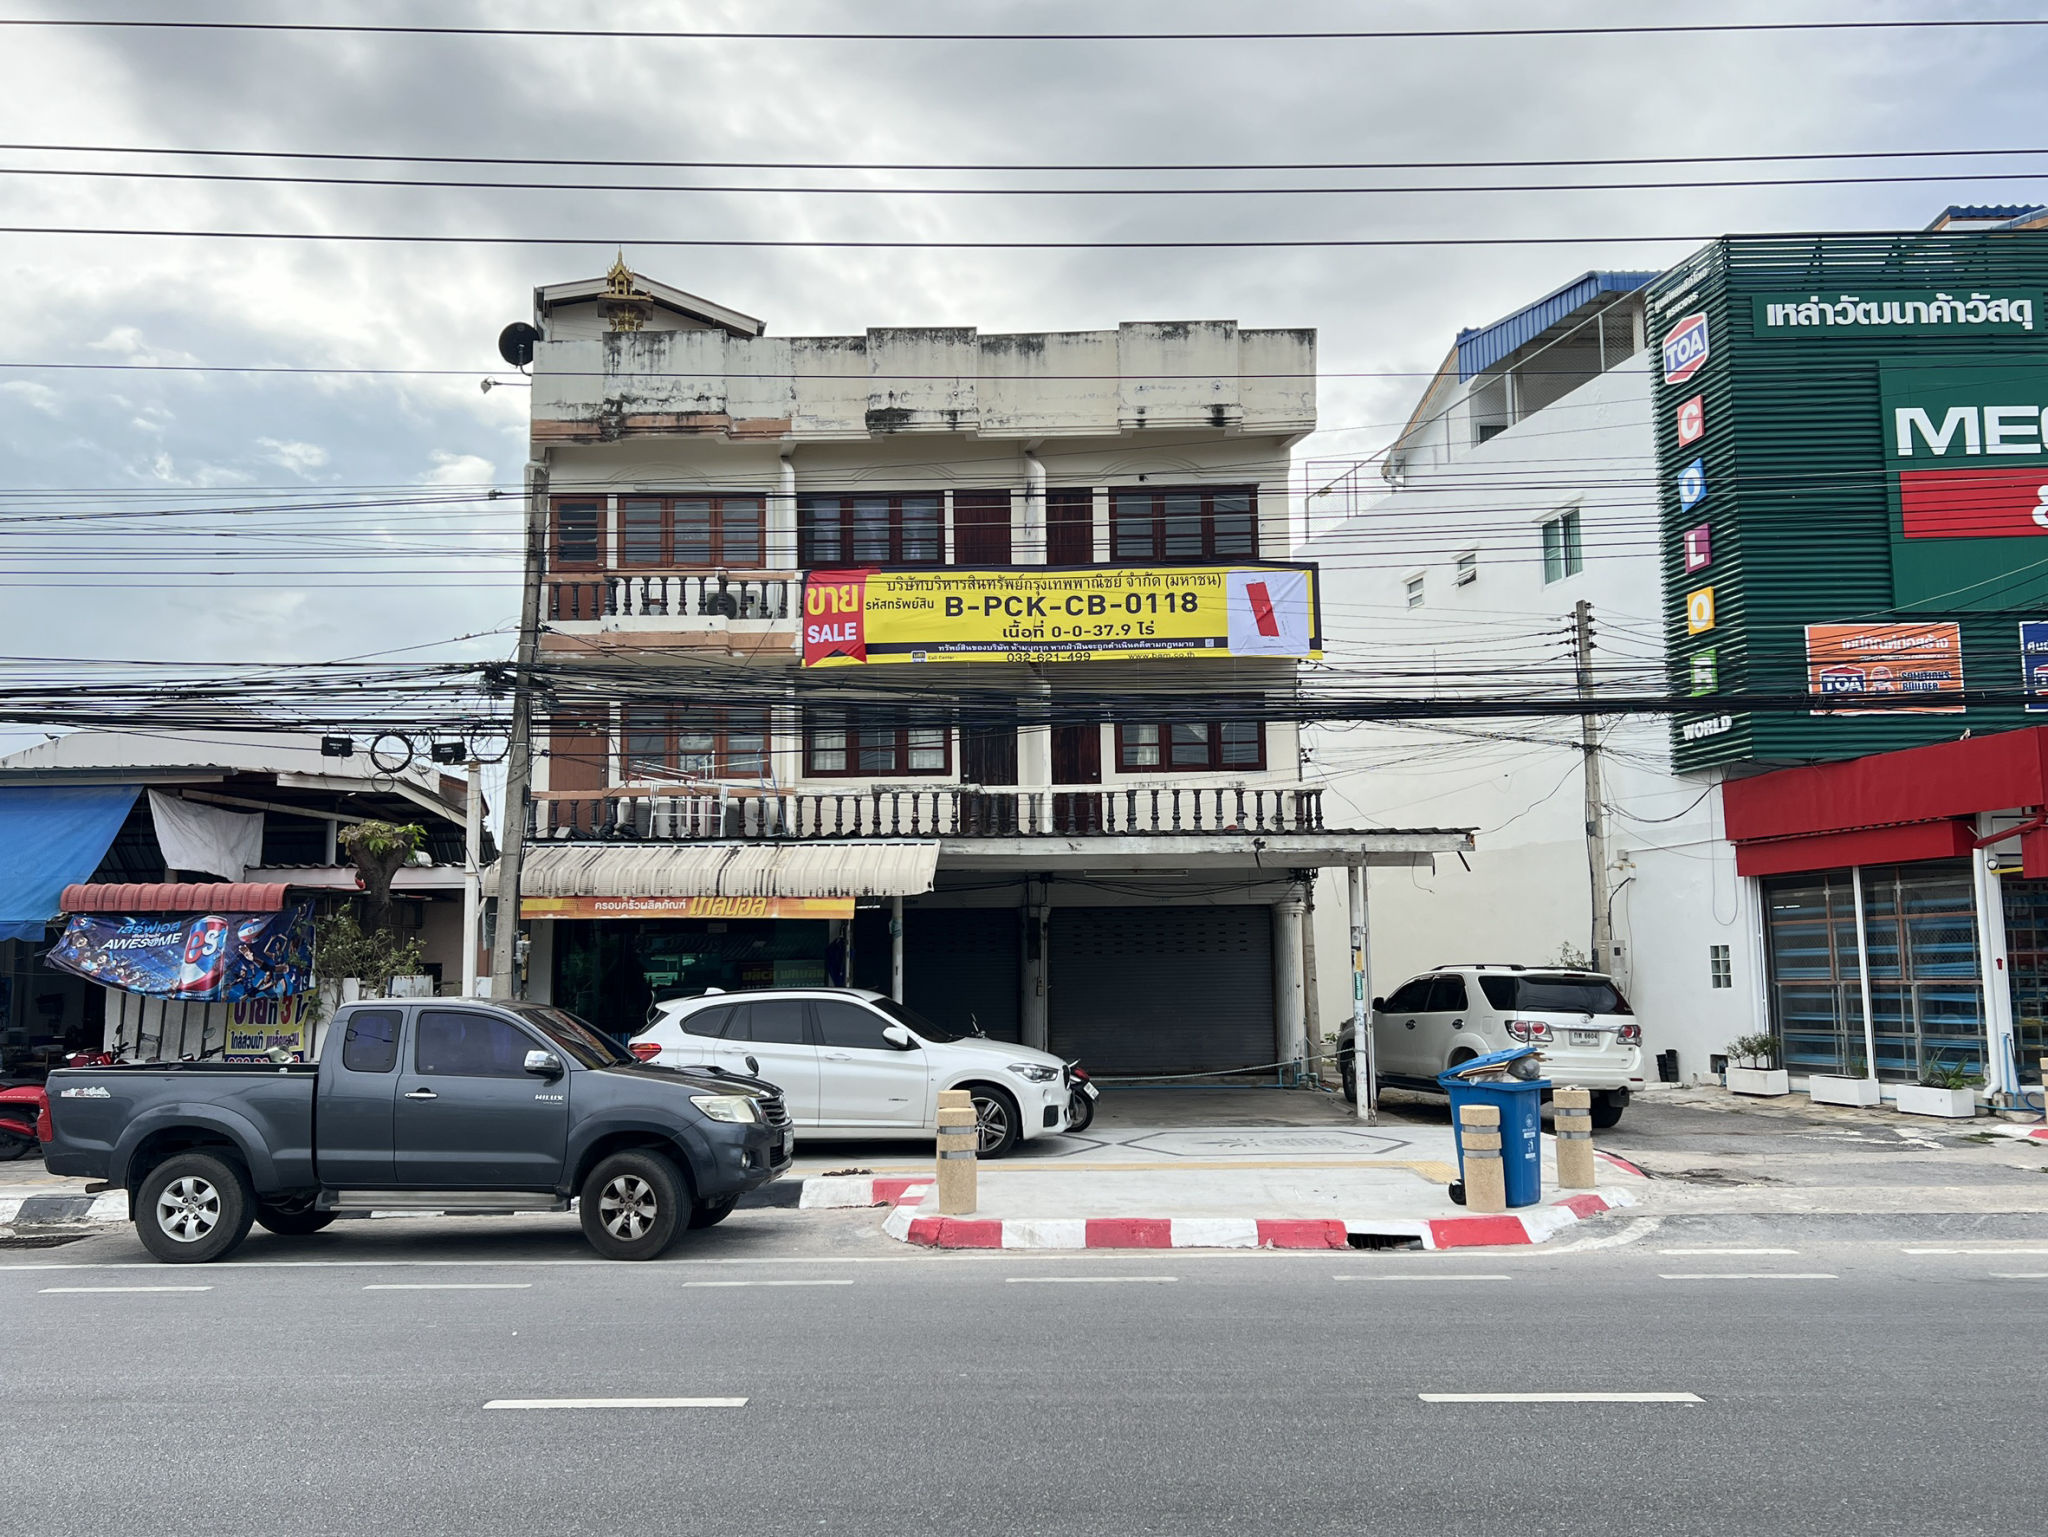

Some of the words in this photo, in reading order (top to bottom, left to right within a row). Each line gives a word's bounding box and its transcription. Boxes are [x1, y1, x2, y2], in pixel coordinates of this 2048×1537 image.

[1766, 293, 2034, 330] เหล่าวัฒนาค้าวัสดุ
[1665, 329, 1704, 370] TOA
[1895, 405, 2048, 457] ME
[887, 573, 1122, 595] บริษัทบริหารสินทรัพย์กรุงเทพพาณิชย์
[1126, 571, 1161, 588] จำกัด
[1165, 573, 1222, 589] (มหาชน)
[807, 584, 859, 616] ขาย
[865, 597, 935, 610] รหัสทรัพย์สิน
[944, 592, 1198, 617] B-PCK-CB-0118
[807, 622, 857, 644] SALE
[1002, 619, 1045, 639] เนื้อที่
[1051, 624, 1131, 638] 0-0-37.9
[1137, 620, 1155, 636] ไร่
[1006, 651, 1091, 663] 032-621-499
[1822, 677, 1864, 693] TOA
[1682, 715, 1733, 741] WORLD
[594, 898, 687, 911] ครอบครัวผลิตภัณฑ์
[101, 933, 183, 950] AWESOME
[280, 994, 293, 1025] 3
